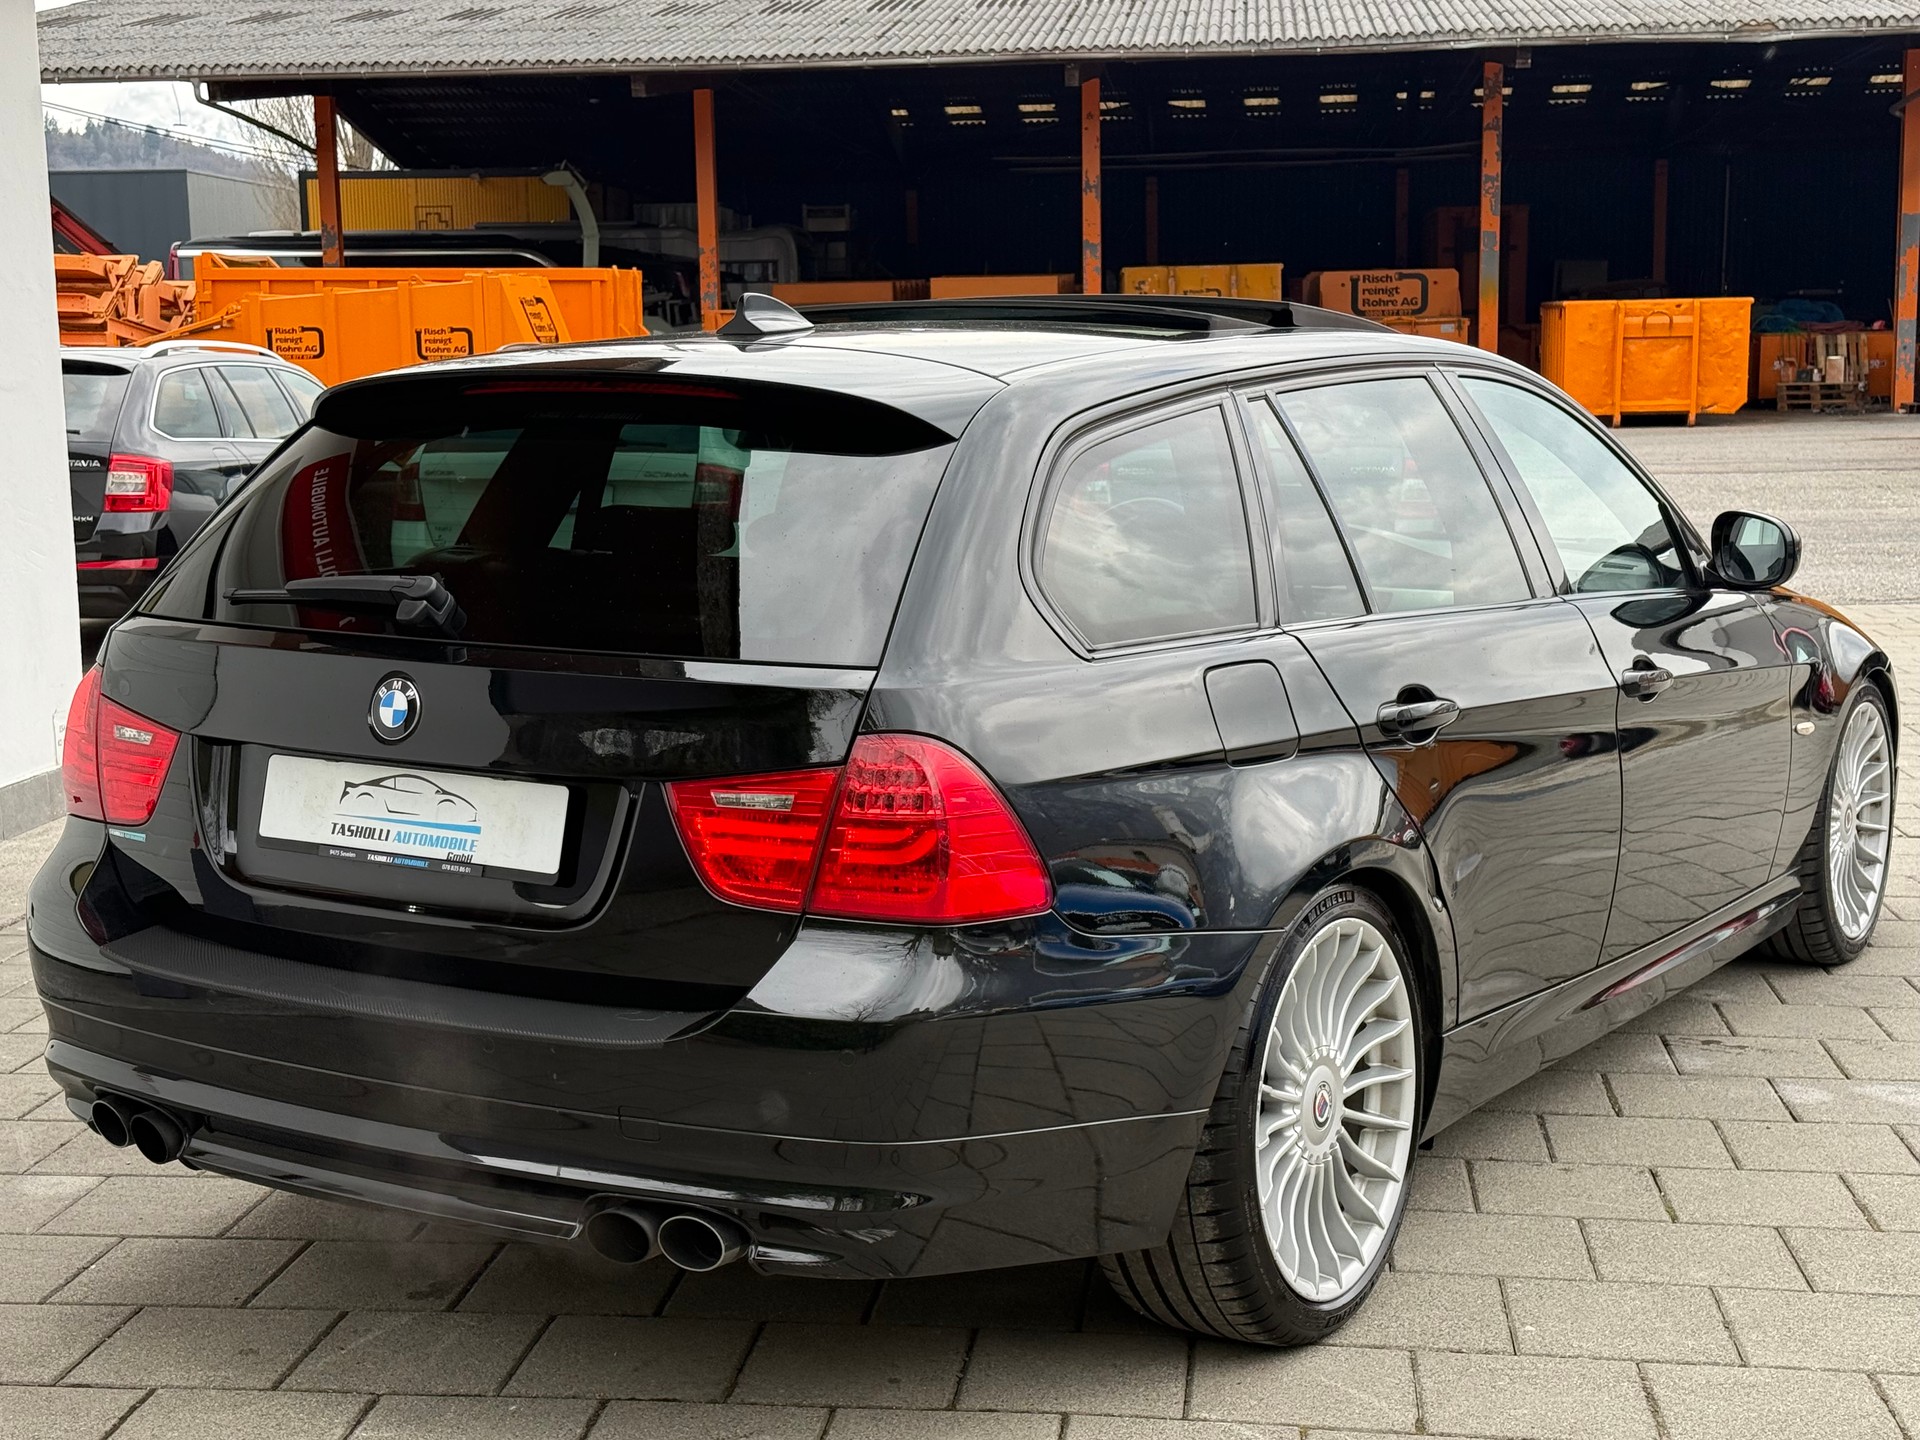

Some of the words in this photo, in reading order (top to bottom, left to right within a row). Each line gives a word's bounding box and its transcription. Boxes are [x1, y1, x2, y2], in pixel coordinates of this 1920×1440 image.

[1362, 274, 1393, 284] Risch
[1362, 286, 1401, 297] reinigt
[1362, 298, 1398, 307] Rohre
[1400, 297, 1419, 307] AG
[274, 327, 298, 335] Risch
[423, 327, 447, 336] Risch
[275, 336, 304, 345] reinigt
[424, 336, 453, 346] reinigt
[275, 345, 303, 353] Rohre
[303, 345, 318, 353] AG
[424, 346, 452, 354] Rohre
[453, 345, 467, 354] AG
[73, 515, 94, 523] 4x4
[378, 680, 416, 701] BMW
[330, 821, 391, 842] TASHOLLI
[392, 830, 480, 853] AUTOMOBILE
[367, 853, 393, 864] TASHOLLI
[393, 856, 430, 868] AUTOMOBILE
[446, 851, 475, 864] GmbH
[1307, 890, 1353, 923] MICHELIN
